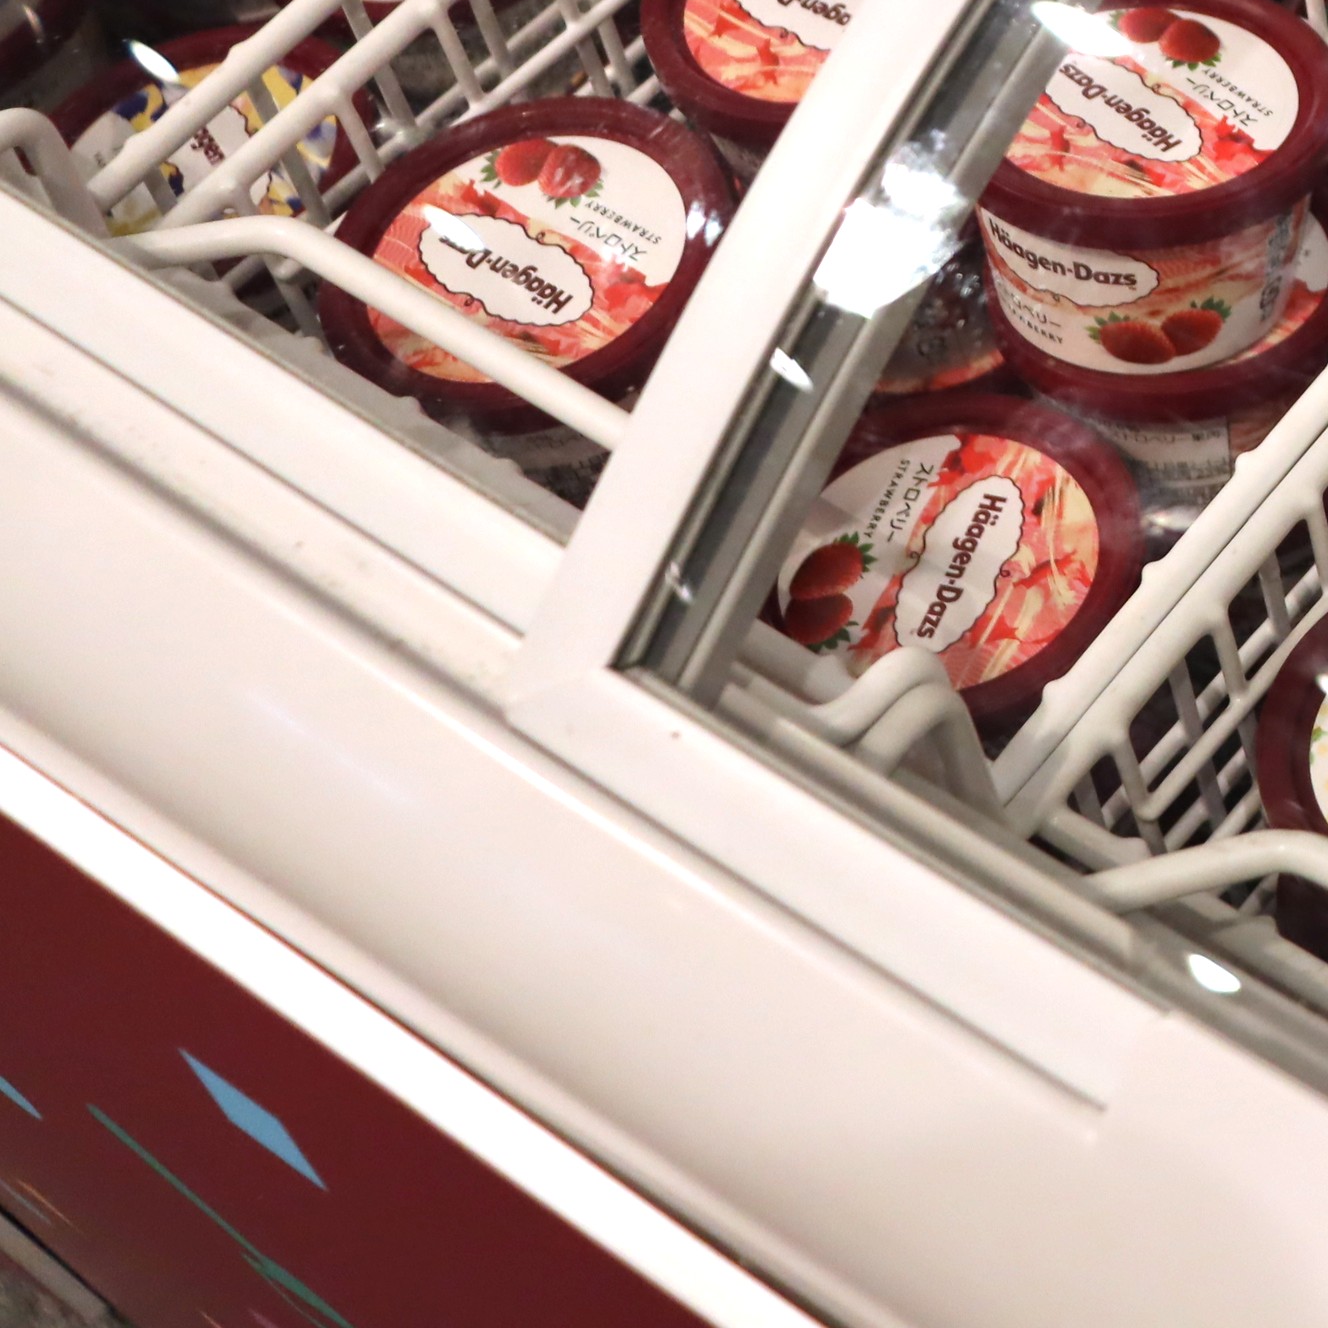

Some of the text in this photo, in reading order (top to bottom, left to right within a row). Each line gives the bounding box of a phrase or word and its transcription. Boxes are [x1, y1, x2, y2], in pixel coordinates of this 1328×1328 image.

[1058, 62, 1183, 153] Häagen-Dazs
[1186, 77, 1259, 127] ストロベリー
[1201, 67, 1274, 117] STRAWBERRY
[569, 215, 649, 263] ストロベリー
[584, 199, 663, 245] STRAWBERRY
[988, 217, 1138, 287] Häagen-Dazs
[438, 235, 574, 315] Häagen-D
[863, 458, 911, 539] STRAWBERRY
[886, 462, 935, 543] ストロベリー
[916, 493, 1008, 639] Häagen-Dazs
